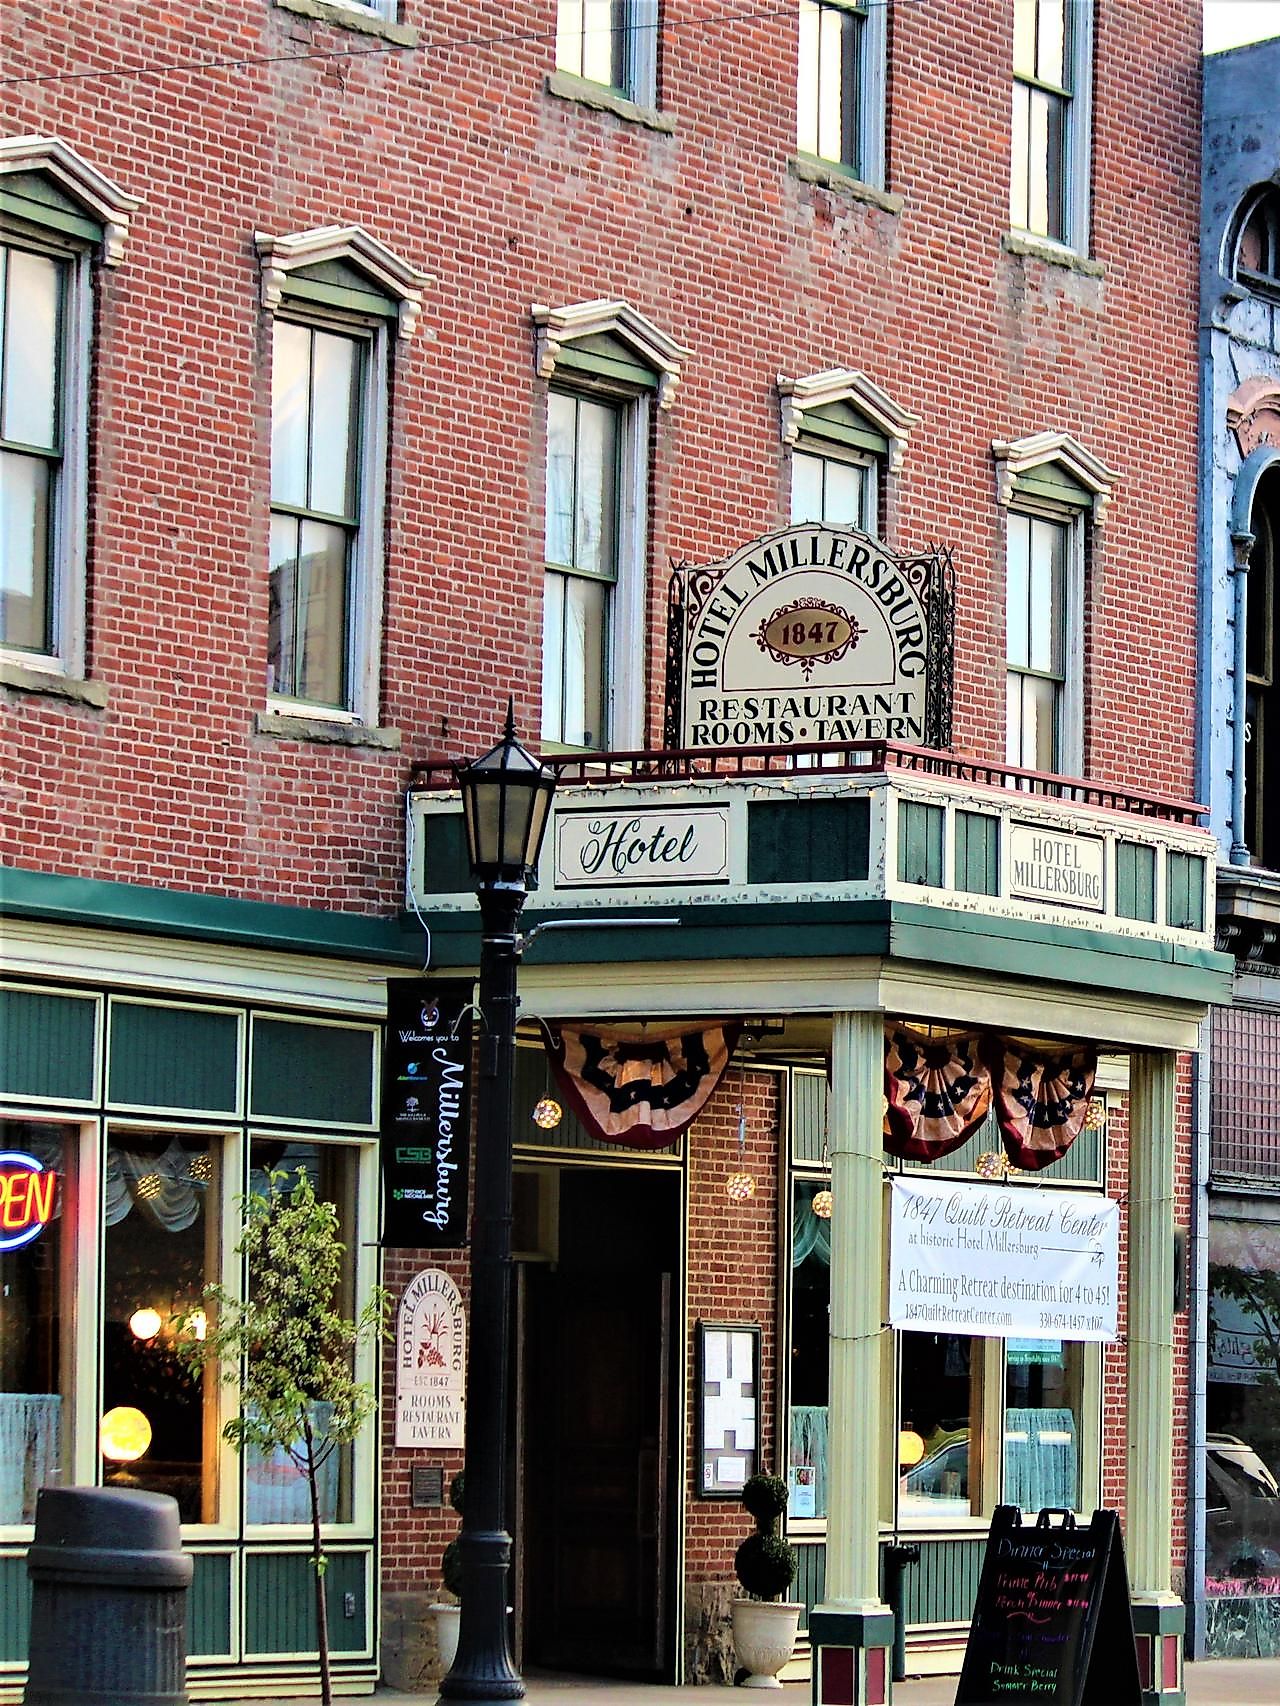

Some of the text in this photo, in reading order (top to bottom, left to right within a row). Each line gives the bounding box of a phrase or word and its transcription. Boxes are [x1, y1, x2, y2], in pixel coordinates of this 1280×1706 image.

[690, 536, 927, 688] HOTEL MILLERSBURG
[782, 622, 839, 646] 1847
[699, 692, 916, 721] RESTAURANT
[691, 716, 922, 746] ROOMS TAVERN
[580, 817, 698, 874] Hotel
[1032, 837, 1081, 868] HOTEL
[1014, 860, 1099, 899] MILLERSBURG
[398, 1030, 434, 1042] Welcomes
[436, 1035, 448, 1043] you
[422, 1048, 465, 1231] Millersburg
[902, 1191, 1109, 1237] 1847 Quilt Retreat Center
[908, 1224, 1039, 1260] at historic Hotel Millersburg
[898, 1269, 1110, 1306] A Charming Retreat destination for 4 to 45!
[402, 1274, 463, 1371] HOTEL MILLERSBURG
[905, 1303, 1013, 1326] 1847QuiltRetreatCenter.com
[430, 1376, 449, 1387] 1847
[411, 1395, 451, 1407] ROOMS
[402, 1410, 460, 1423] RESTAURANT
[412, 1426, 451, 1439] TAVERN
[998, 1538, 1096, 1560] Dinner Special
[990, 1661, 1058, 1678] Drink Special
[1031, 1680, 1057, 1694] Berry
